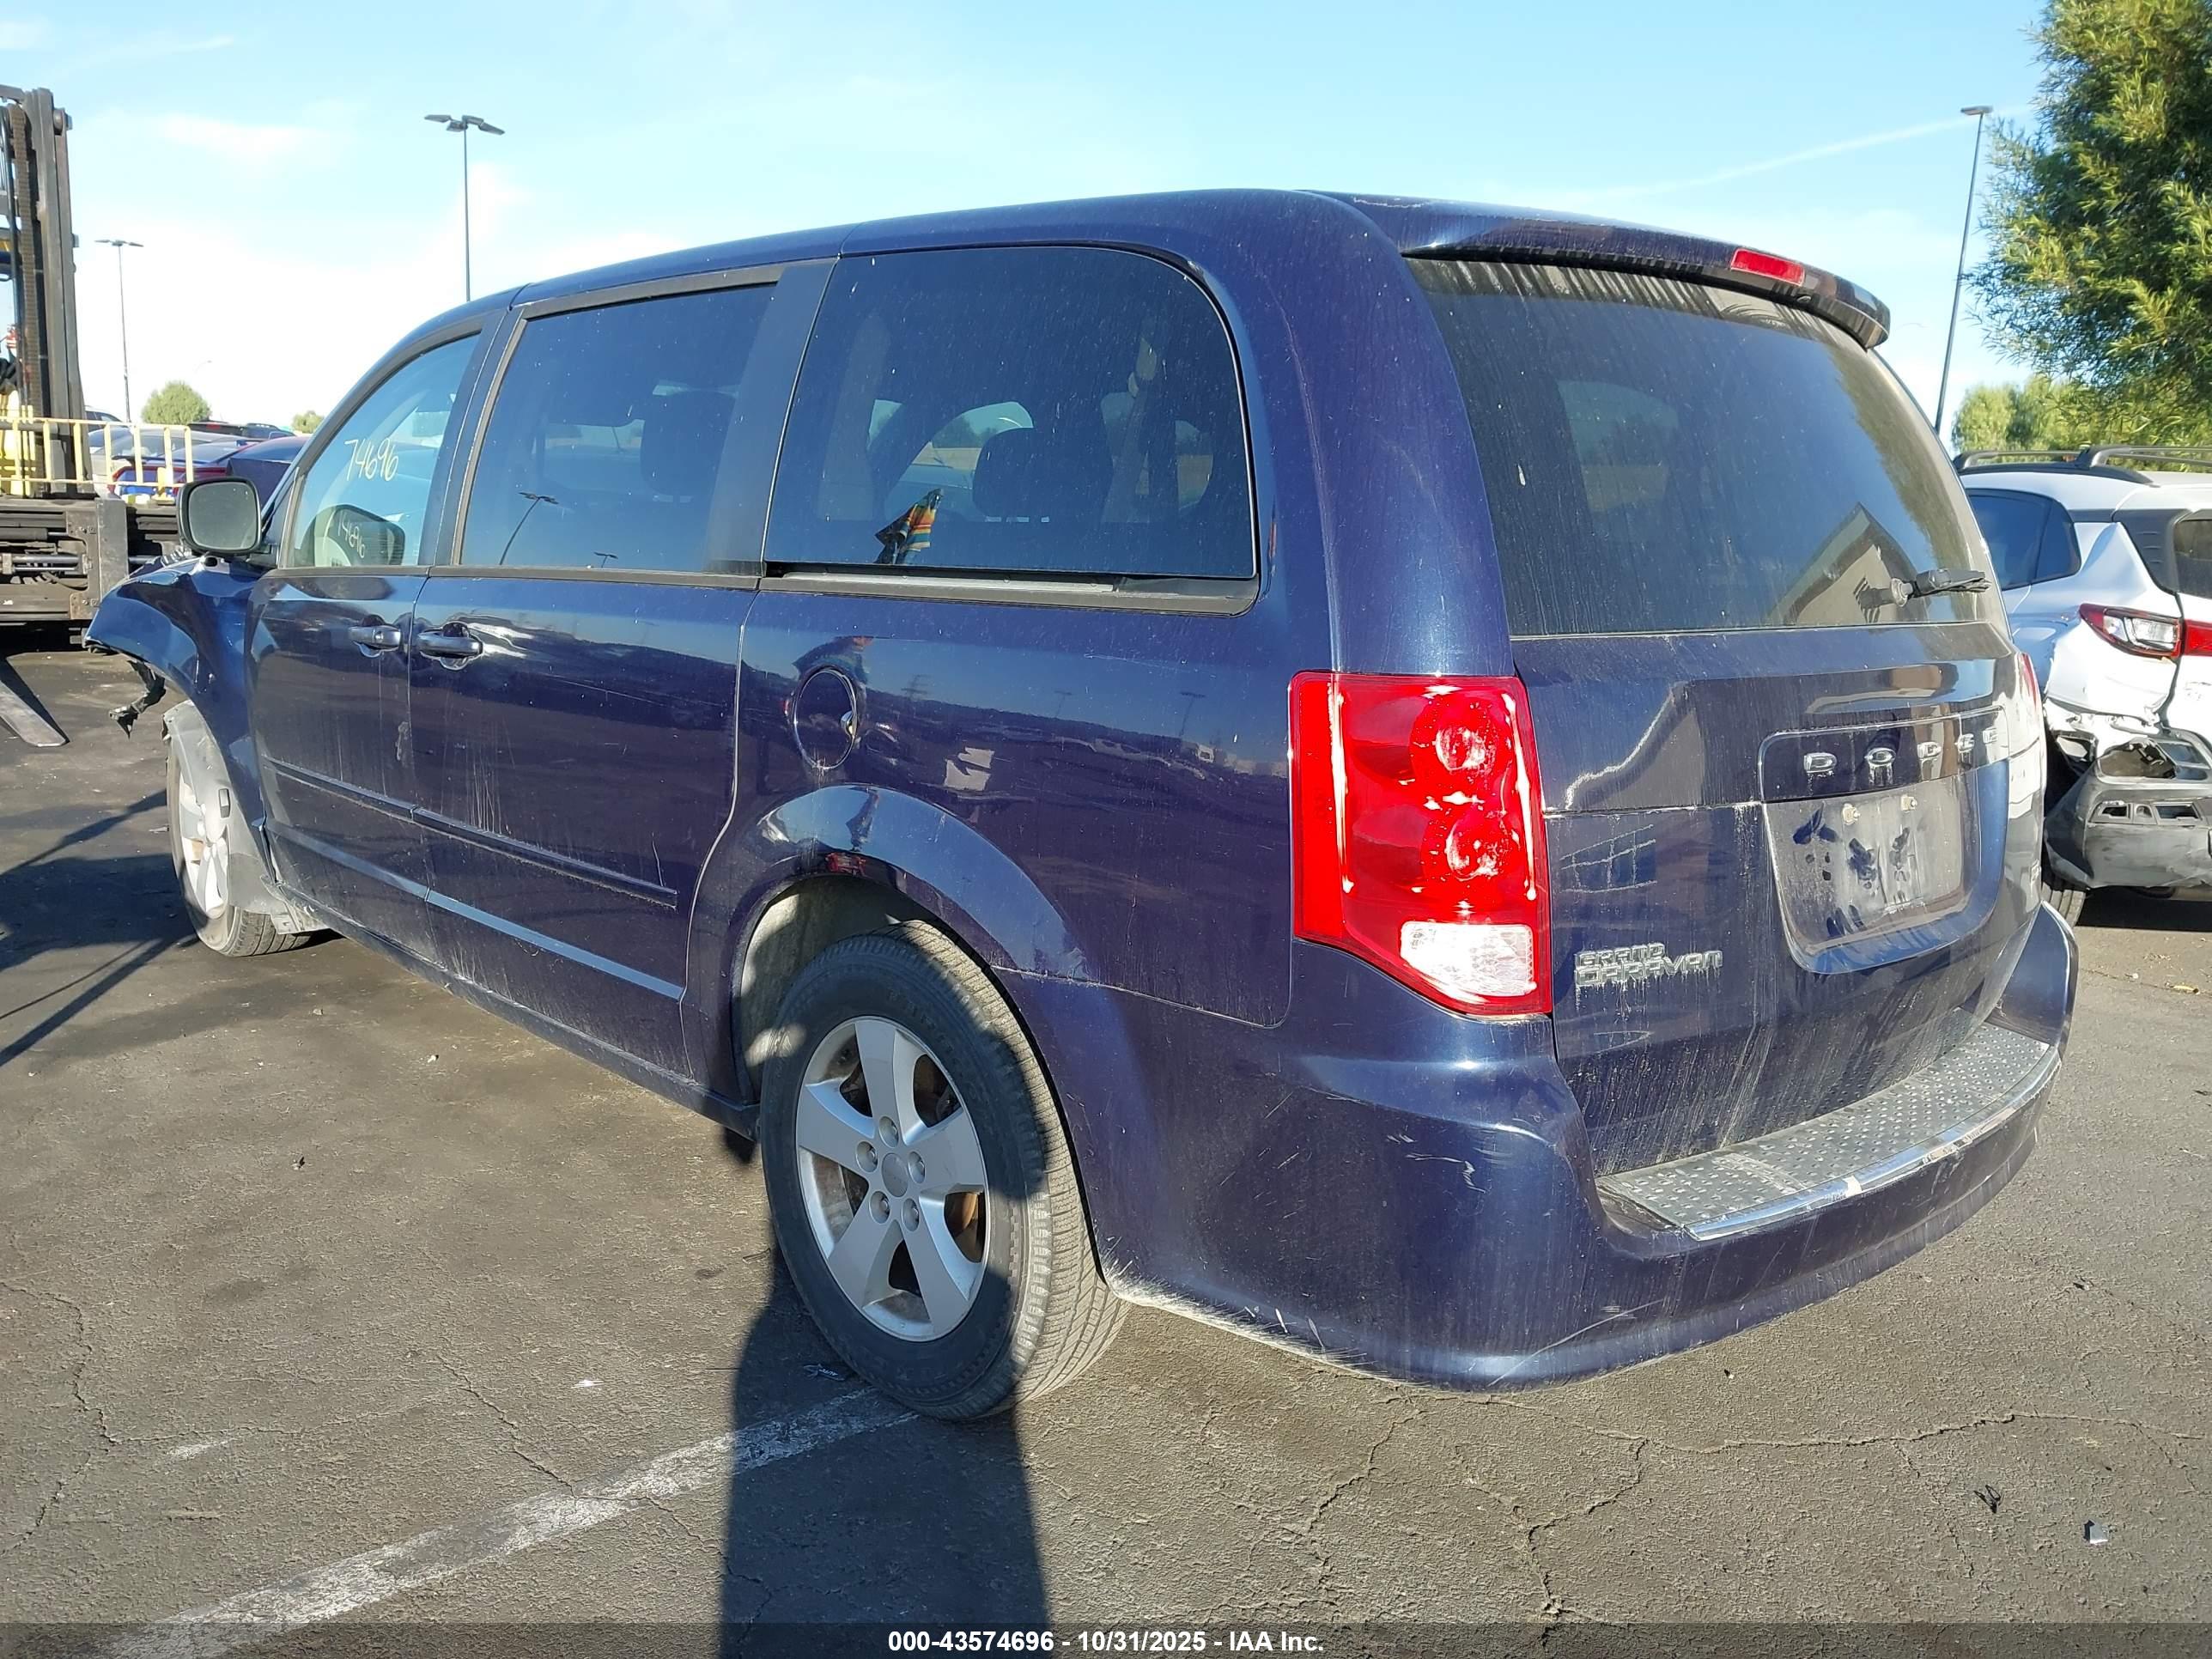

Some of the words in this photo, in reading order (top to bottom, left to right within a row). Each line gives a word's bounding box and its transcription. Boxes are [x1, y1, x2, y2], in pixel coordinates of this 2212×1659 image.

[344, 438, 399, 482] 74696
[1803, 728, 1999, 773] DODGE
[1575, 950, 1723, 987] CARAVAN
[1576, 943, 1665, 969] GRAND
